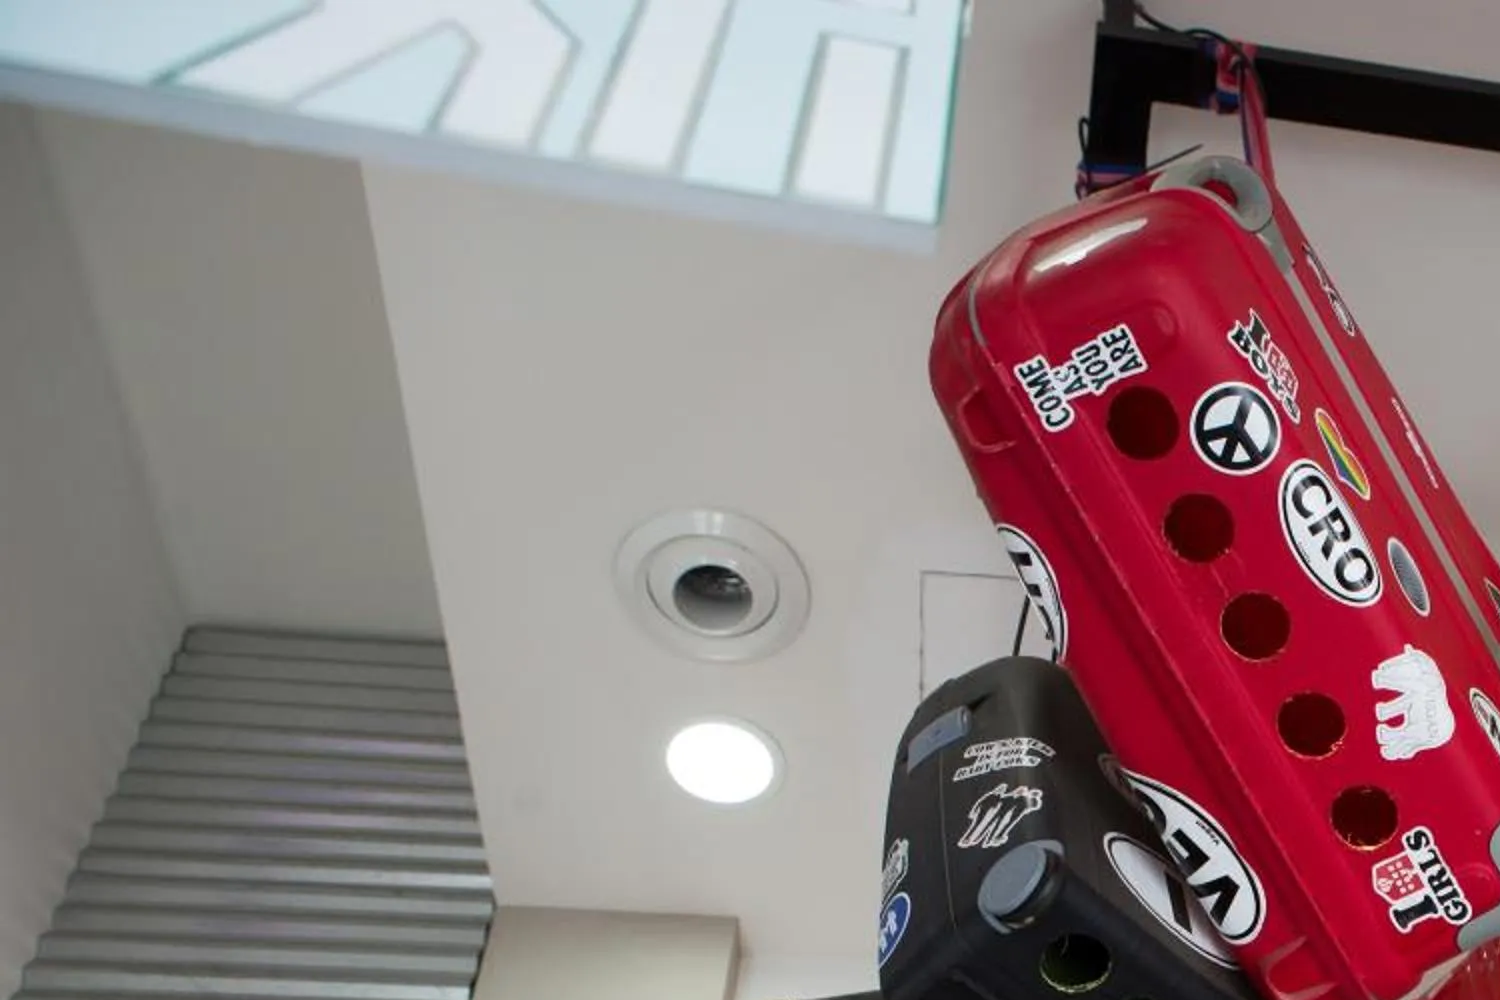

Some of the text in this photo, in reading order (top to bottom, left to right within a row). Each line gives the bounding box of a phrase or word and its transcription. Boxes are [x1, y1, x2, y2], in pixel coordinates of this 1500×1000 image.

[1054, 364, 1089, 394] AS
[1075, 343, 1115, 391] YOU
[1101, 327, 1142, 373] ARE
[1018, 358, 1071, 427] COME
[1294, 473, 1374, 593] CRO
[1406, 829, 1469, 922] GIRLS
